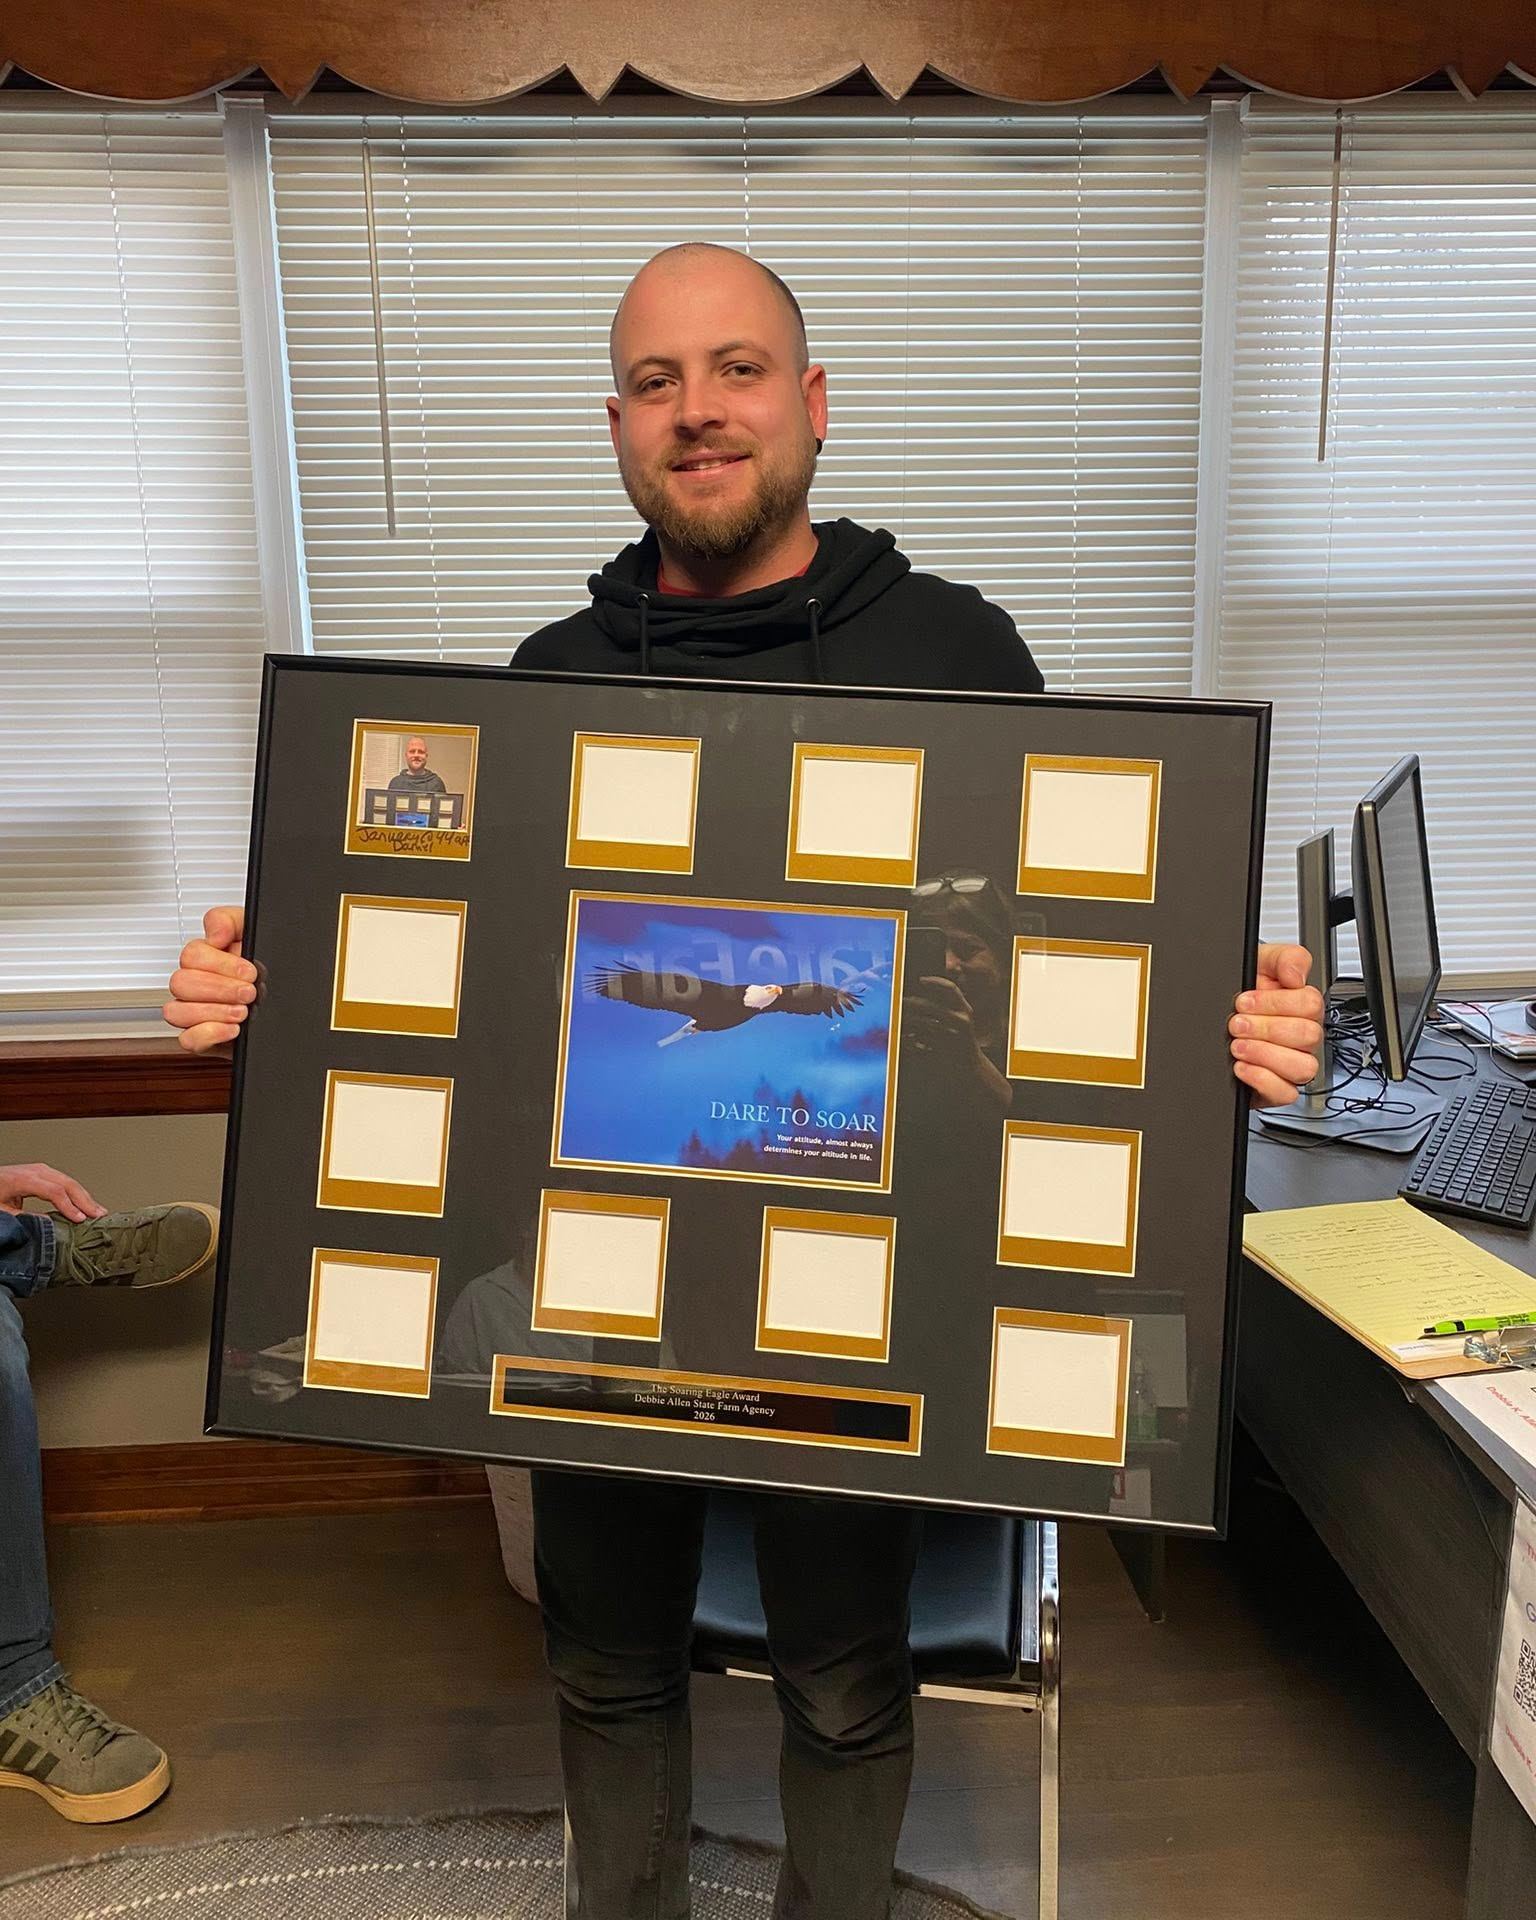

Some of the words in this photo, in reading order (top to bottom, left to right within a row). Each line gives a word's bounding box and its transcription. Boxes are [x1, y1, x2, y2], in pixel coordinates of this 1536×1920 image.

[711, 1101, 770, 1123] DARE
[776, 1107, 810, 1126] TO
[815, 1110, 878, 1133] SOAR
[777, 1134, 793, 1142] Your
[794, 1136, 824, 1145] attitude,
[825, 1138, 849, 1147] almost
[850, 1140, 874, 1149] always
[763, 1145, 802, 1155] determines
[803, 1149, 820, 1157] your
[821, 1151, 848, 1159] altitude
[858, 1153, 873, 1162] life.
[651, 1384, 668, 1394] The
[669, 1385, 703, 1398] Soaring
[705, 1389, 730, 1400] Eagle
[732, 1392, 760, 1402] Award
[634, 1393, 665, 1405] Debbie
[667, 1397, 691, 1407] Allen
[693, 1399, 715, 1410] State
[717, 1402, 740, 1412] Farm
[742, 1405, 776, 1417] Agency
[693, 1411, 716, 1421] 2026
